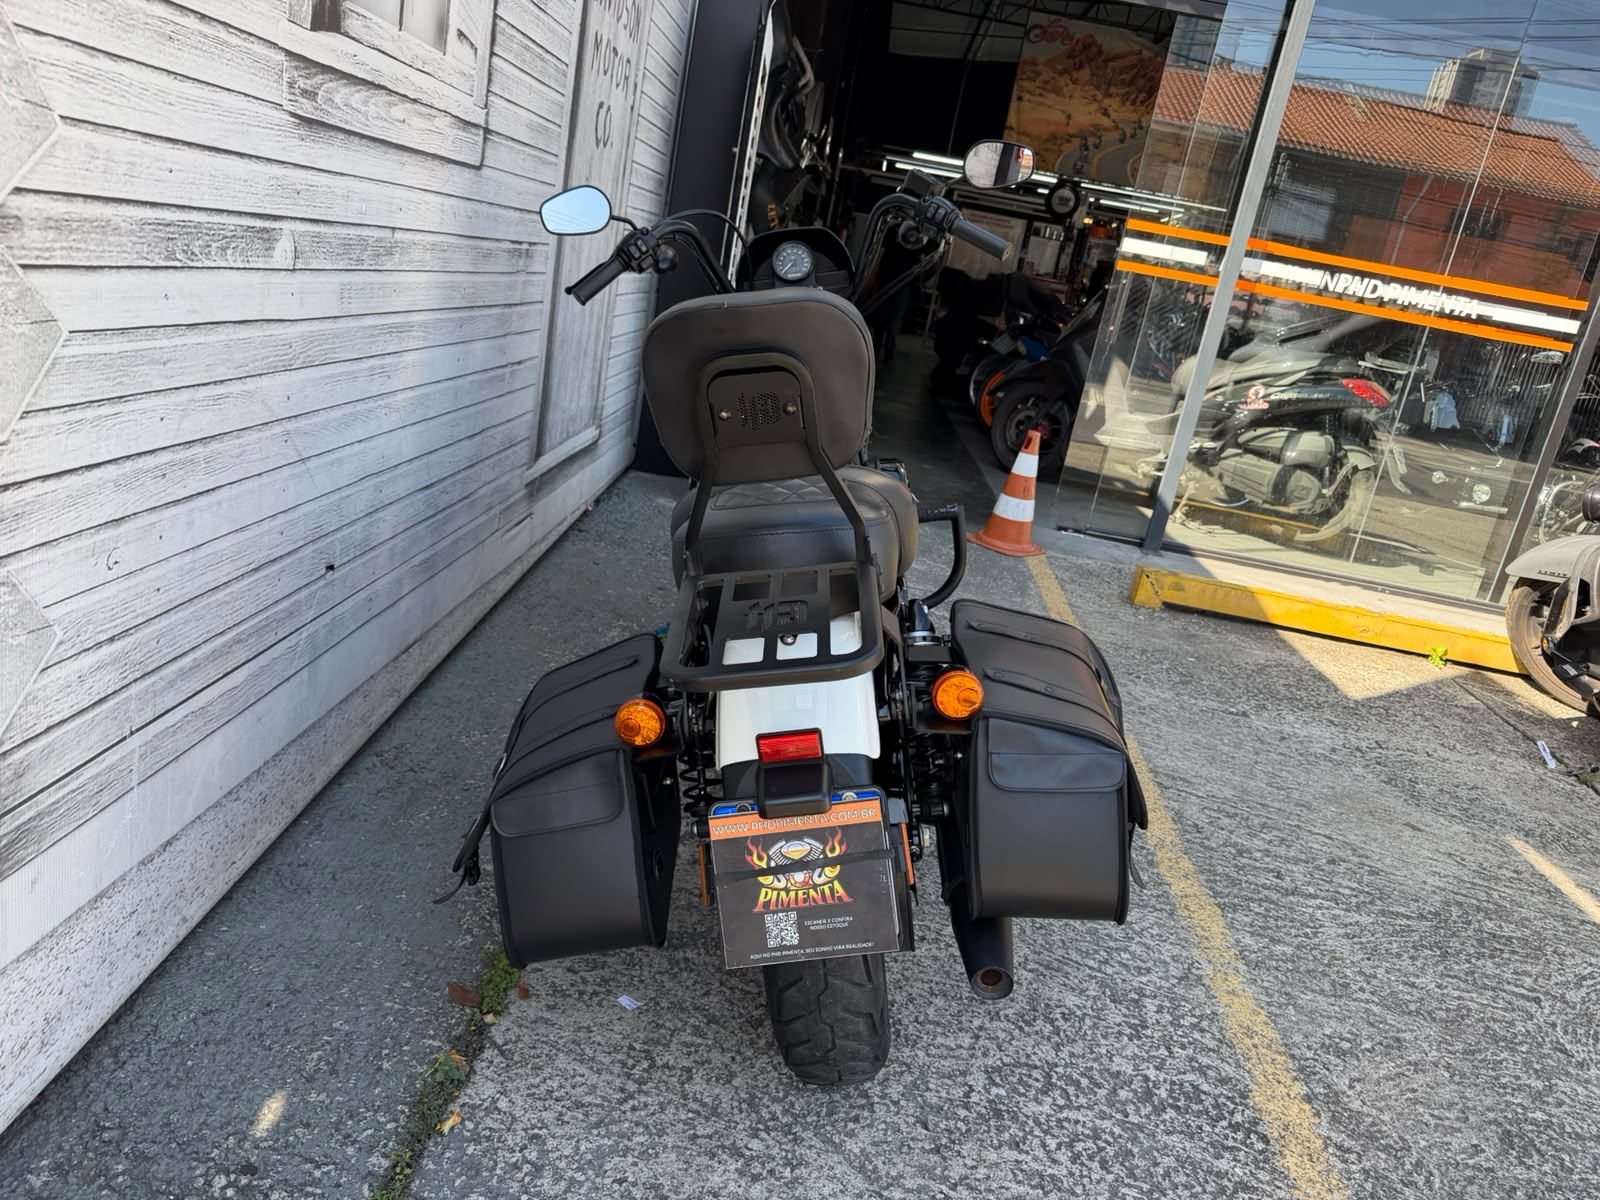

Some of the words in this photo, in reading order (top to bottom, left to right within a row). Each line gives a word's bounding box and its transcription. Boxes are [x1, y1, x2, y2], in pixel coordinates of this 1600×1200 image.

[594, 0, 641, 44] IDSON
[591, 30, 631, 100] MOTOR
[595, 101, 614, 150] CO.
[1383, 282, 1479, 320] PIMENTA
[712, 807, 876, 835] WWW.PHDPIMENTA.COM.BR
[752, 880, 853, 912] PIMENTA
[846, 941, 875, 949] REALIDADE!
